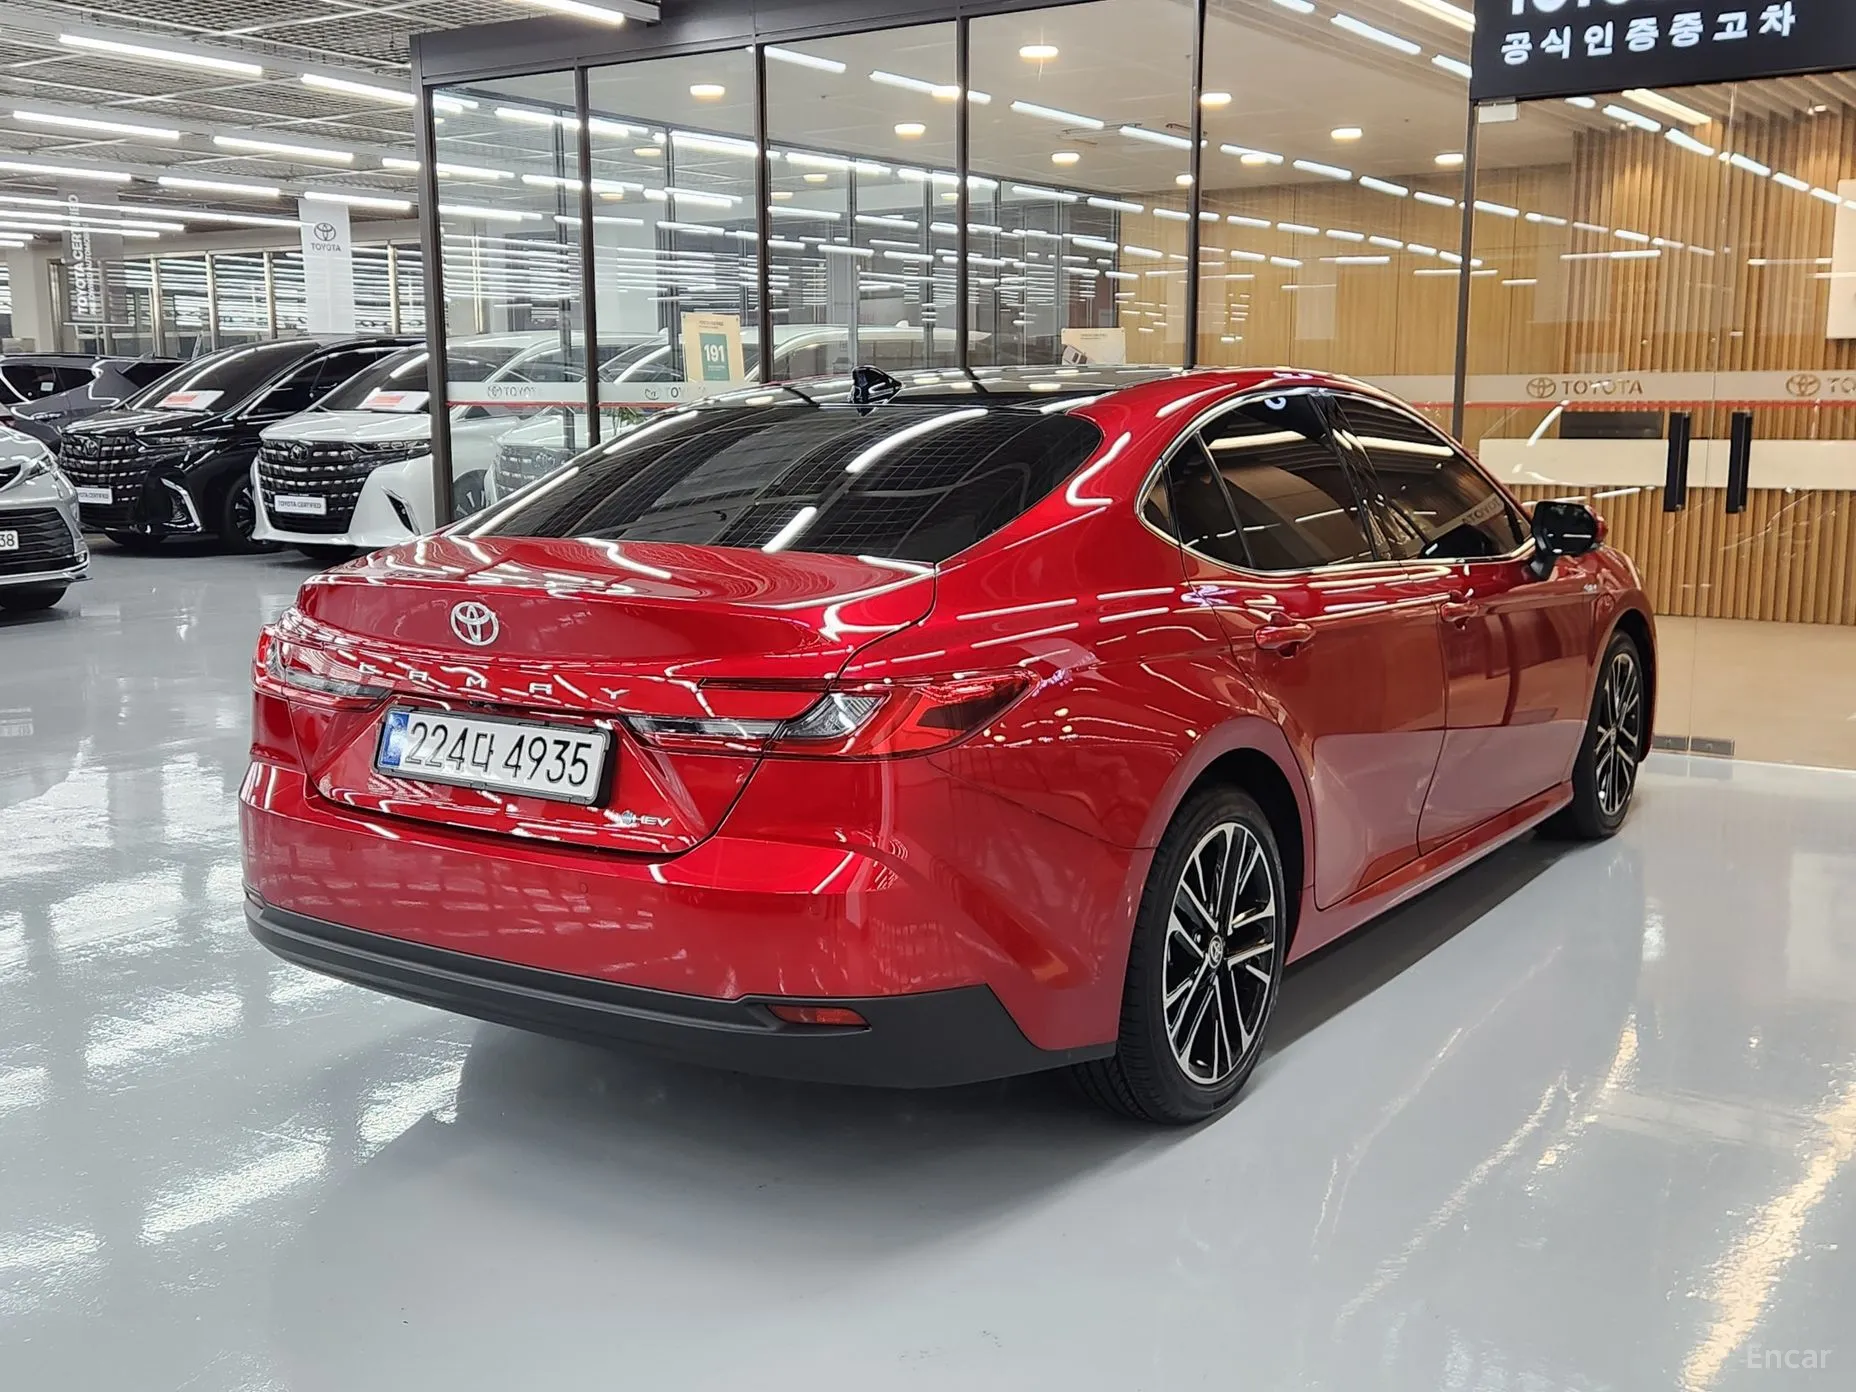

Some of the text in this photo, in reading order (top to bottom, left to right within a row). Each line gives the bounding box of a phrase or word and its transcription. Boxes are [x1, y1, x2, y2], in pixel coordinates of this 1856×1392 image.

[68, 194, 91, 315] TOYOTA CERIIED
[311, 243, 342, 252] TOYOTA
[704, 344, 725, 362] 191
[1562, 380, 1643, 395] TOYOTA
[502, 734, 592, 786] 4935
[633, 814, 672, 827] HEV
